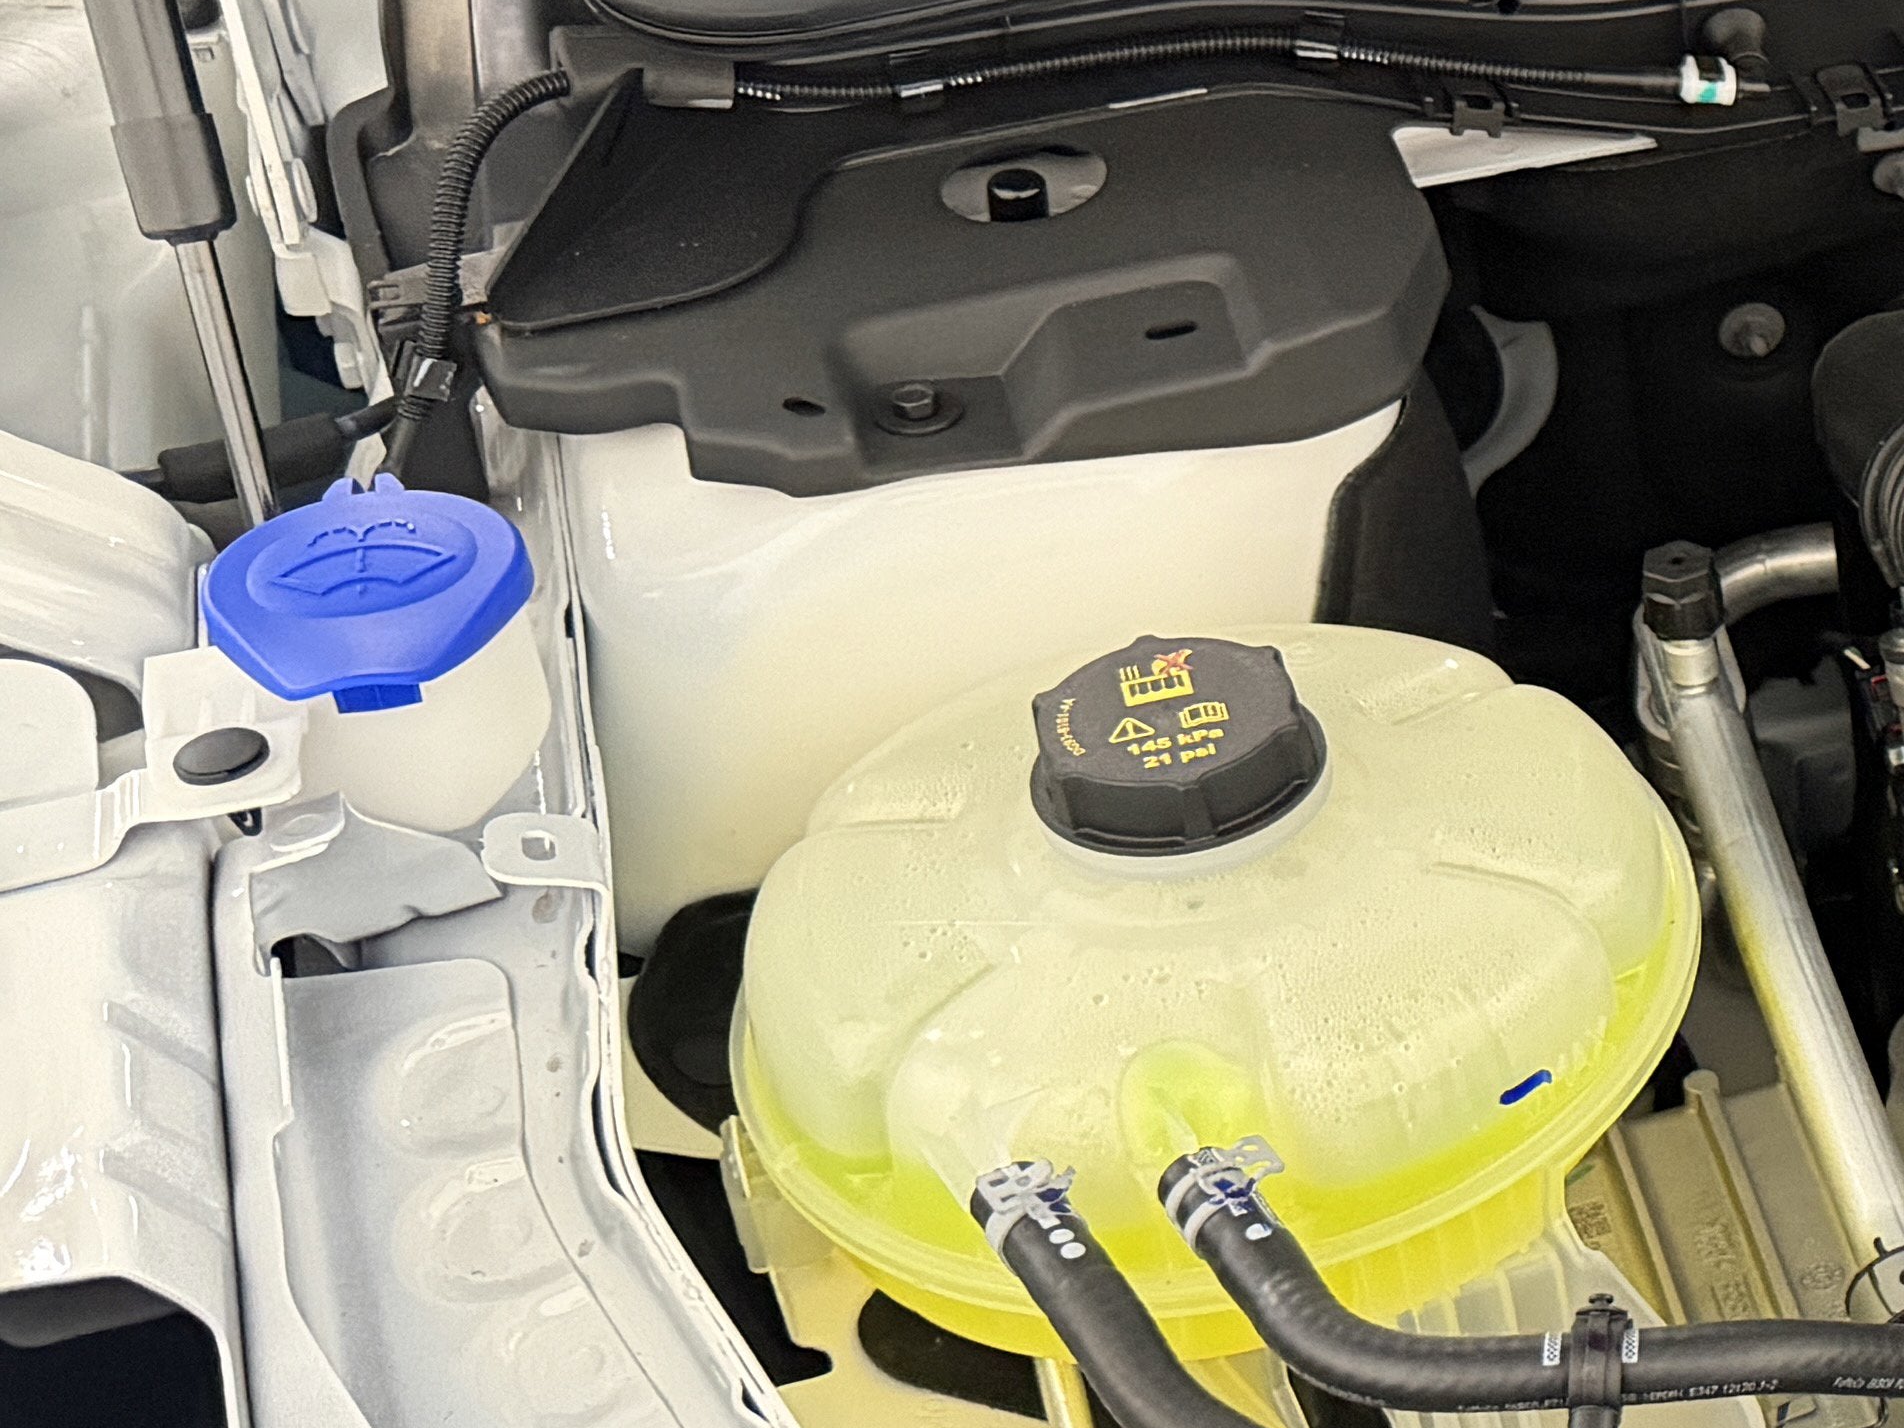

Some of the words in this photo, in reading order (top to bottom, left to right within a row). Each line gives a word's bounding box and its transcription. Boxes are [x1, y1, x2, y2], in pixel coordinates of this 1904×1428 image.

[1127, 737, 1171, 755] 145
[1176, 729, 1223, 745] kPa
[1143, 753, 1171, 768] 21
[1180, 743, 1216, 763] psi
